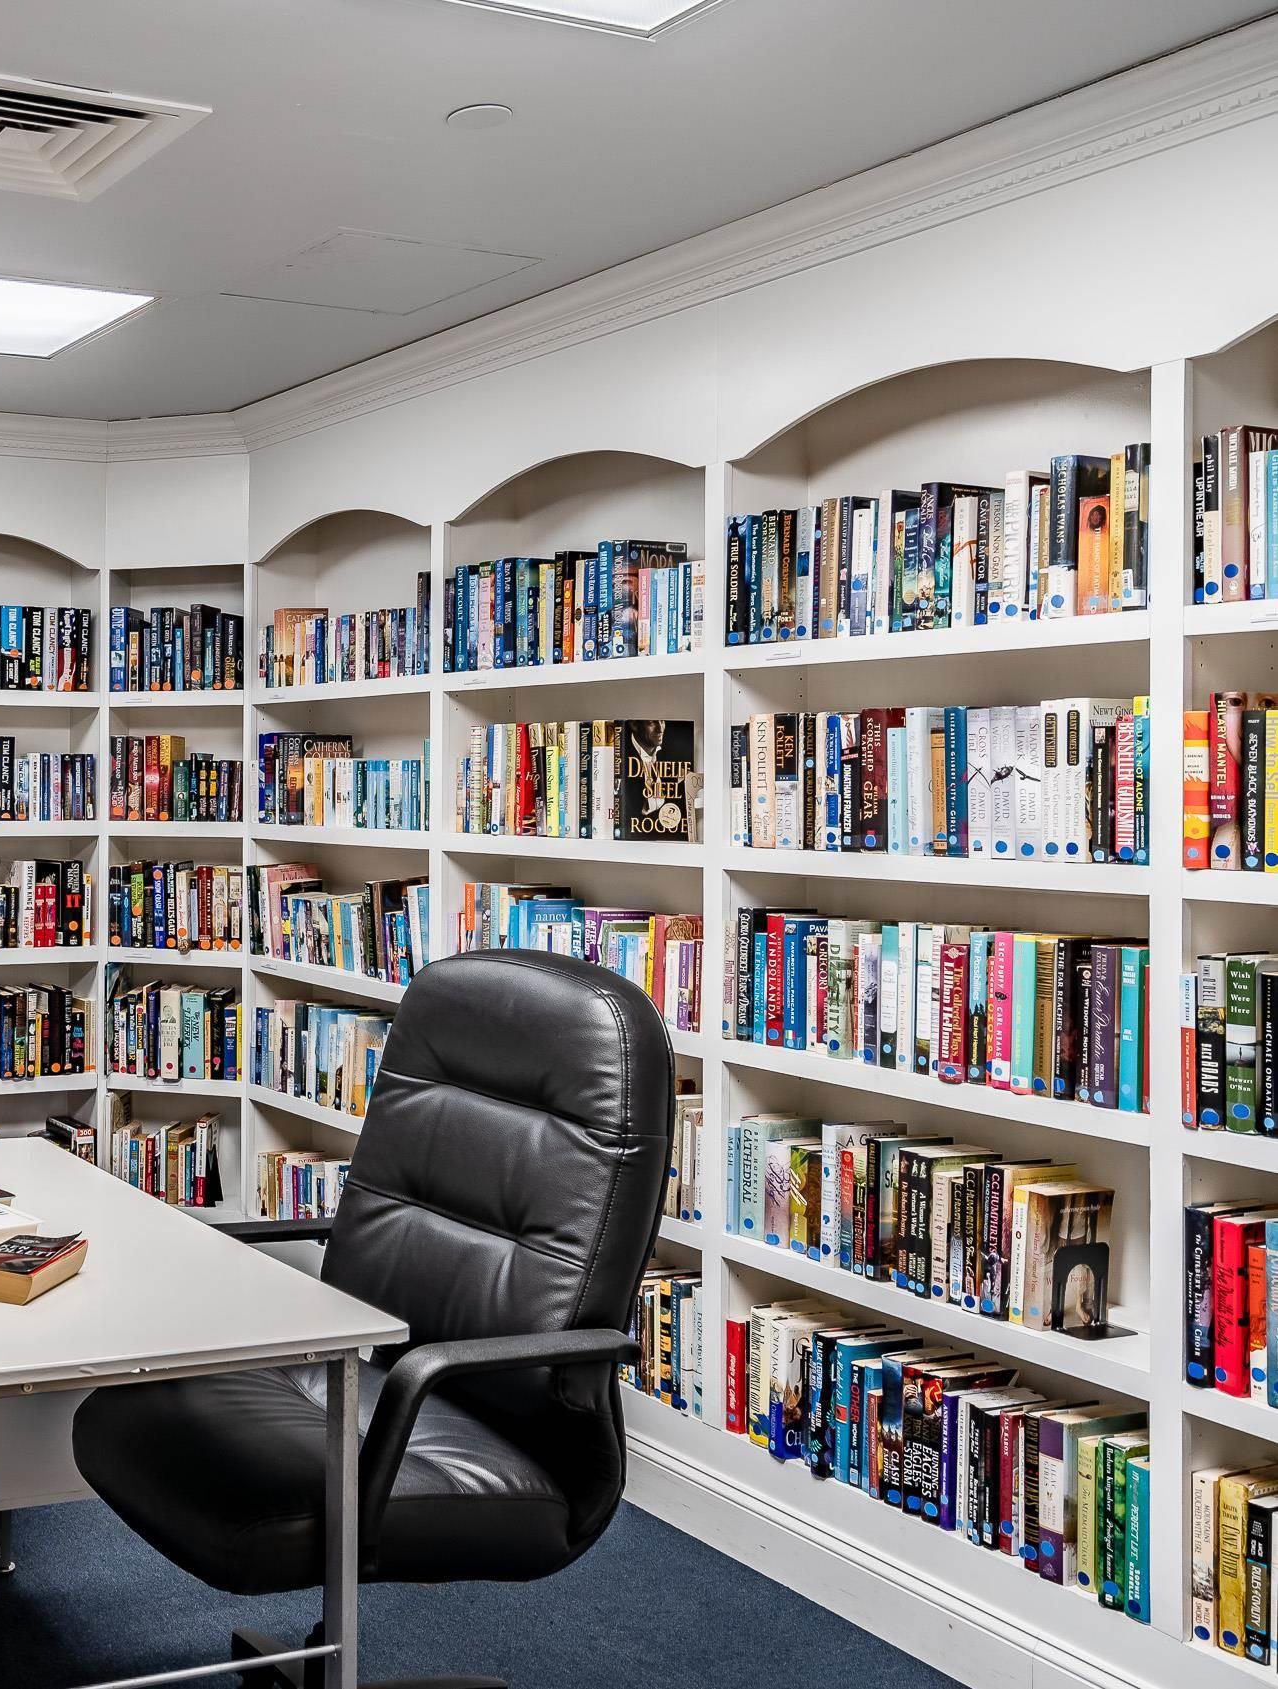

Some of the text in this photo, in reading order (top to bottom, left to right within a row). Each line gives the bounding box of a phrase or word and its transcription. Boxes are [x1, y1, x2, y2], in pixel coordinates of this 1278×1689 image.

[1206, 475, 1214, 493] klay
[768, 516, 777, 564] BERNARD
[978, 500, 987, 580] CAVEAT EMPTOR
[456, 568, 464, 621] JODI PICOULT
[599, 552, 608, 608] NORA ROBERTS
[32, 611, 41, 655] TOM CLANCY
[1093, 706, 1112, 716] NEWT
[304, 740, 350, 752] CATHERINE
[733, 731, 741, 758] bridget
[756, 722, 767, 790] KEN FOLLETT
[785, 735, 793, 758] KEN
[866, 717, 874, 772] SCORCHED
[968, 733, 976, 752] FIRE
[978, 727, 987, 758] CROSS
[1016, 730, 1025, 760] HAWK
[1030, 723, 1039, 765] SHADOW
[1045, 715, 1056, 766] GETTYSBURG
[1217, 701, 1226, 787] HILARY MANTEL
[628, 757, 691, 778] DANIELLE
[643, 780, 682, 798] STEEL
[843, 764, 851, 833] JONATHAN FRANZEN
[864, 781, 873, 819] GEAR
[1247, 733, 1257, 842] SEVEN BLACK DIAMONDS
[66, 894, 81, 908] IT
[535, 911, 567, 923] nancy
[573, 920, 582, 953] AFTER
[768, 932, 776, 1020] VINDOLANDA
[972, 939, 982, 1000] The Possibilities
[1203, 978, 1215, 1002] O'DELL
[183, 1008, 191, 1050] LIMERICK
[942, 962, 954, 1058] Lillian Hellman
[1202, 1063, 1218, 1093] ROADS
[1229, 1076, 1253, 1084] Stewart
[1230, 1084, 1251, 1092] O'Nan
[742, 1128, 752, 1203] CATHEDRAL
[989, 1191, 999, 1253] HUMPHREYS
[851, 1385, 860, 1422] OTHER
[890, 1451, 899, 1485] CLASH
[904, 1447, 912, 1485] STORM
[913, 1443, 922, 1484] EAGLES
[922, 1446, 932, 1498] EAGLES
[931, 1451, 939, 1492] HUNTING
